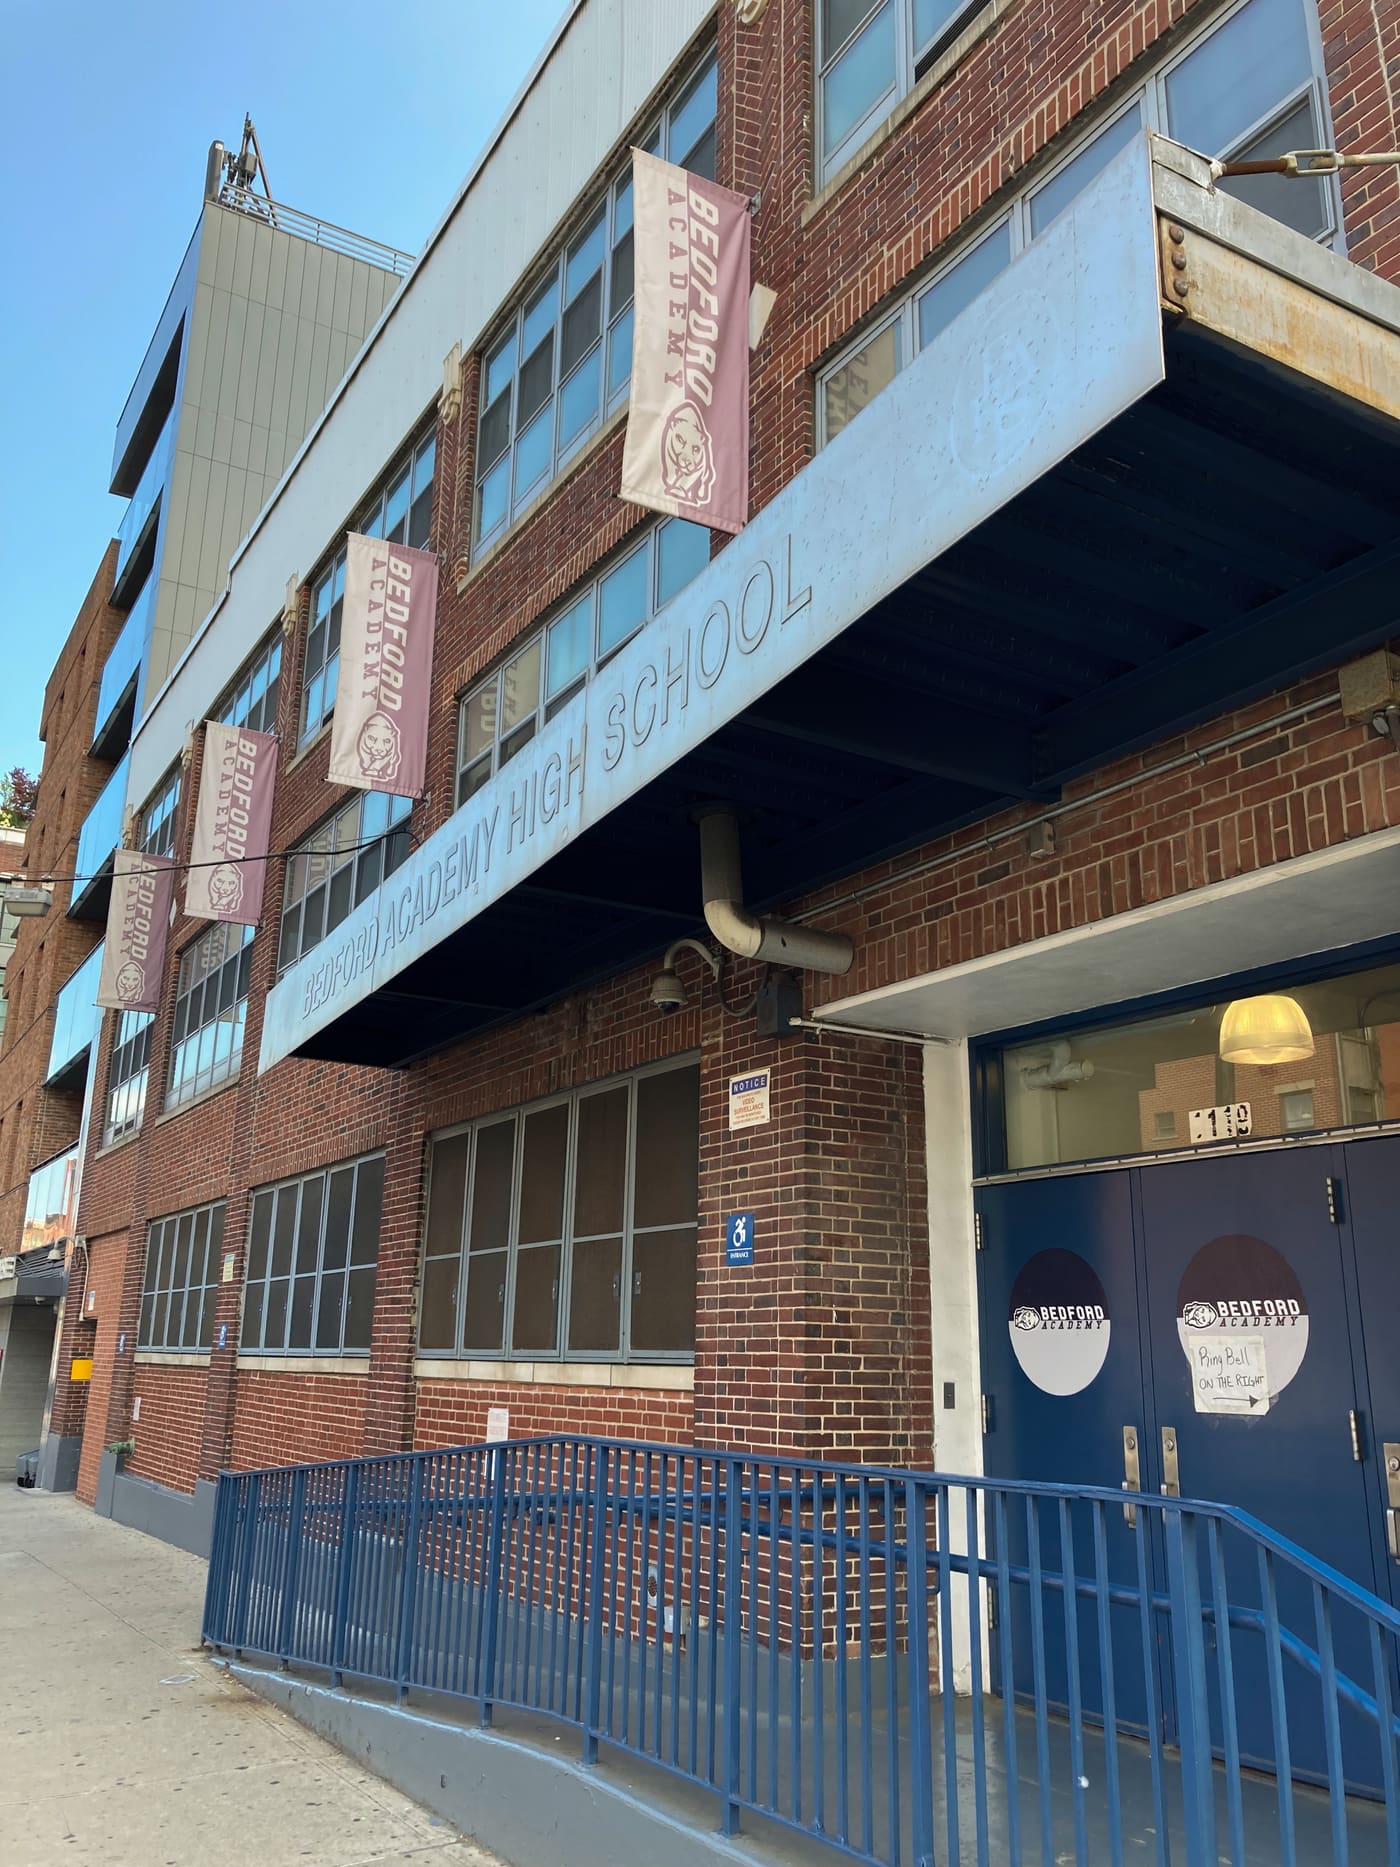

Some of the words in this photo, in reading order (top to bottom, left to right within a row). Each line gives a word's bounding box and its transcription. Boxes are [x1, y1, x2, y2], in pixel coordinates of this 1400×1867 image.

[664, 187, 687, 385] ACADEMY
[684, 188, 719, 407] BEDFORD
[362, 557, 386, 700] ACADEMY
[379, 555, 412, 713] BEDFORD
[212, 739, 237, 853] ACADEMY
[225, 737, 257, 861] BEDFORD
[302, 916, 379, 1020] BEDFORD
[381, 805, 500, 958] ACADEMY
[507, 722, 588, 855] HIGH
[602, 533, 812, 773] SCHOOL
[120, 862, 141, 956] ACADEMY
[129, 860, 158, 960] BEDFORD
[733, 1076, 766, 1093] NOTICE
[1040, 1305, 1105, 1321] BEDFORD
[1041, 1320, 1104, 1331] ACADEMY
[1217, 1298, 1301, 1317] BEDFORD
[1218, 1316, 1299, 1328] ACADEMY
[1199, 1346, 1223, 1376] Ring
[1225, 1346, 1250, 1366] Bell
[1199, 1378, 1214, 1390] ON
[1216, 1375, 1234, 1389] THE
[1236, 1373, 1264, 1387] RIGHT
